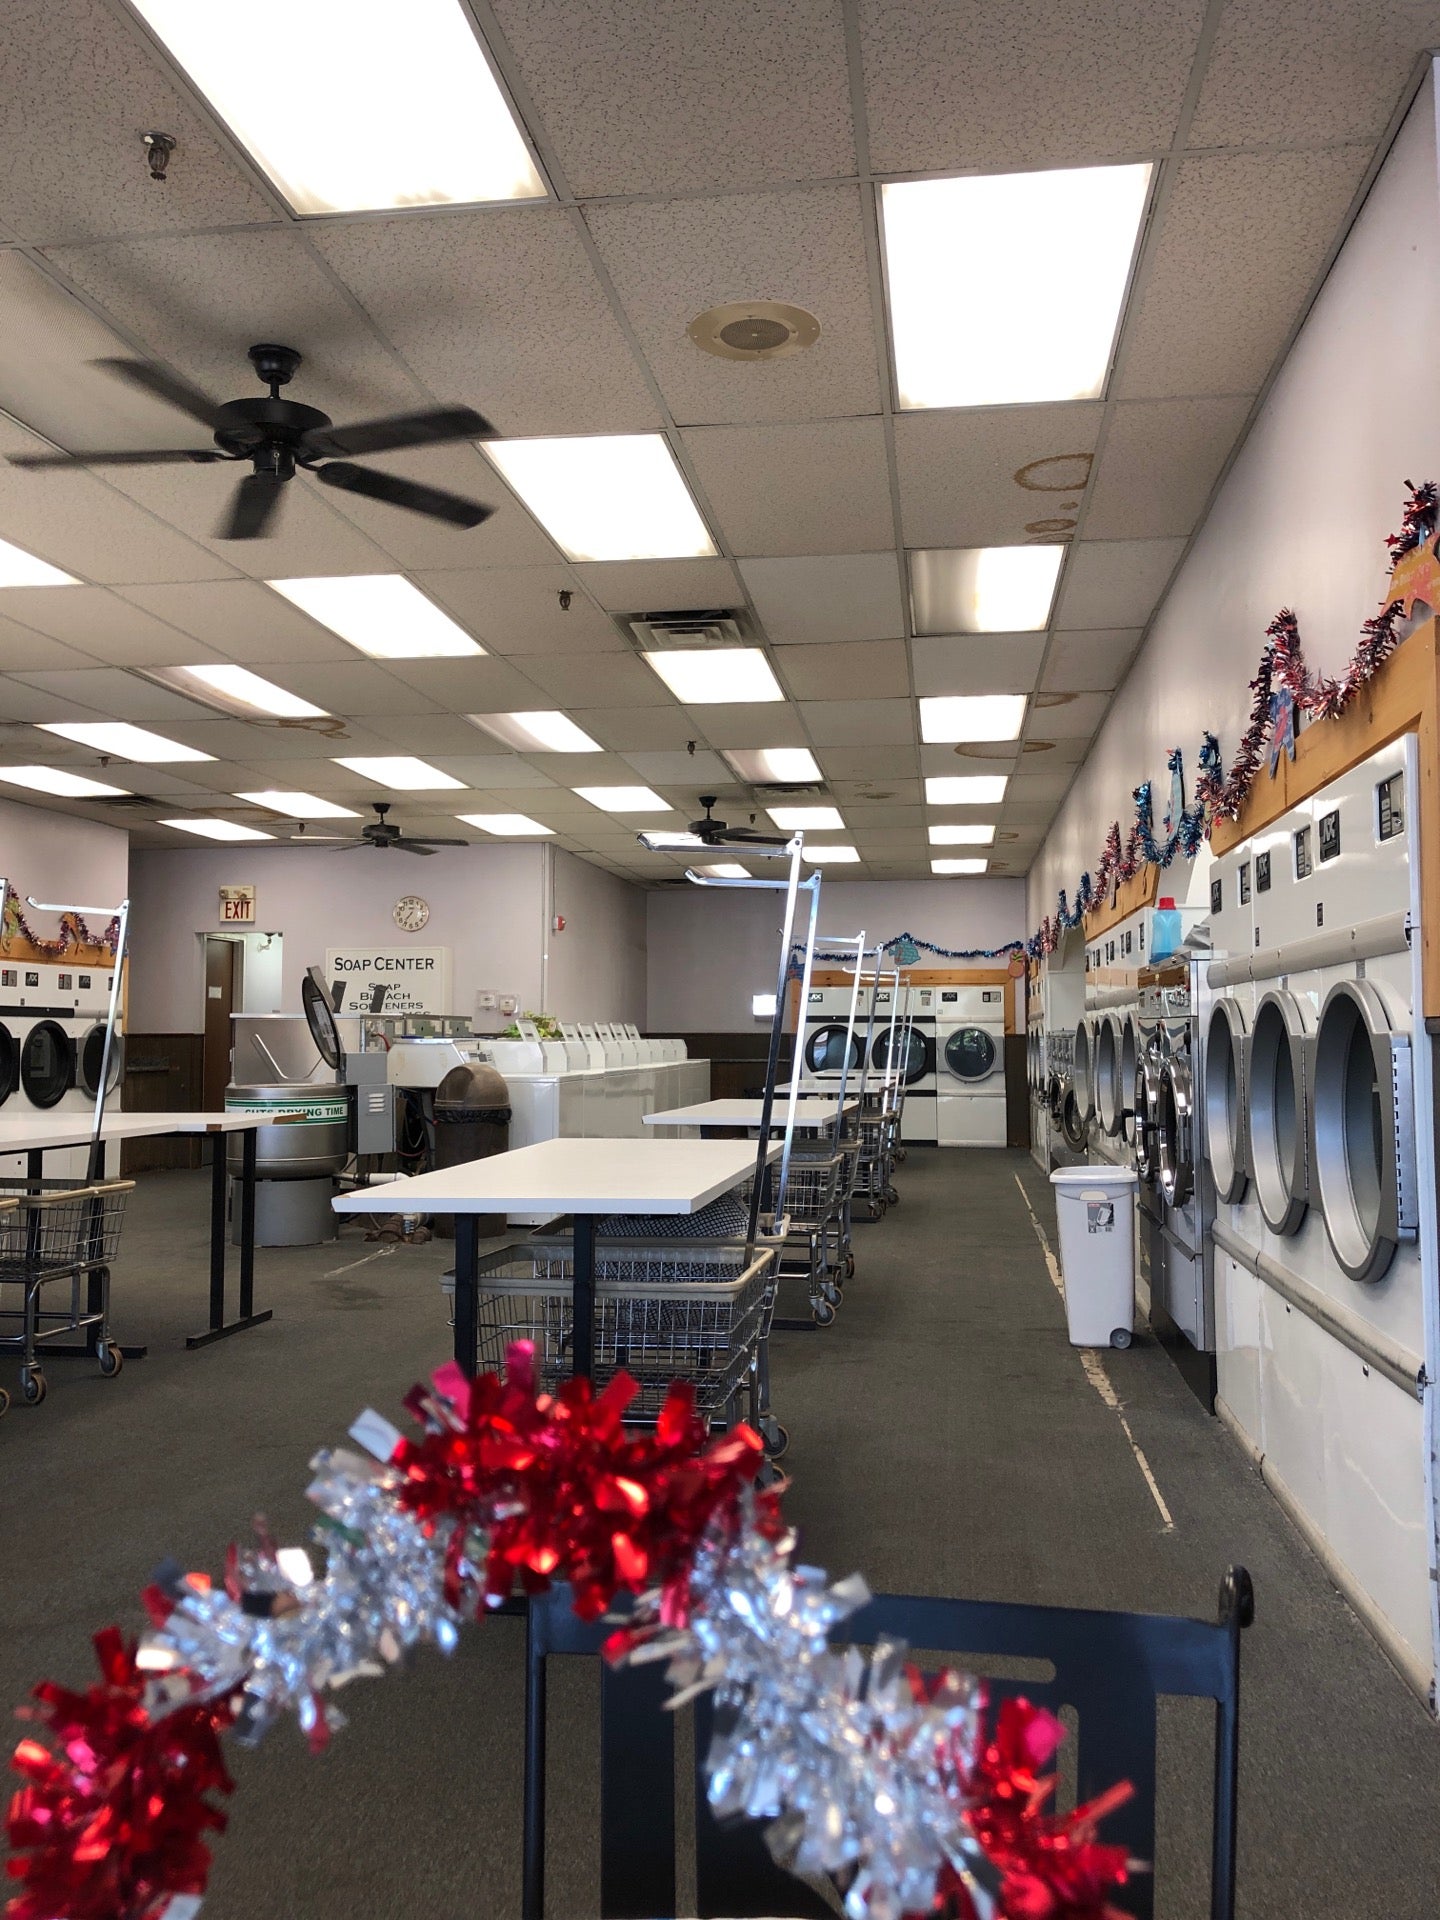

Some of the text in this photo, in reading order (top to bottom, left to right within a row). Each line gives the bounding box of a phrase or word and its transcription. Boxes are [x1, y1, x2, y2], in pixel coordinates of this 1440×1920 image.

[225, 901, 251, 919] EXIT
[334, 956, 434, 971] SOAP CENTER
[368, 982, 401, 991] SAP
[360, 992, 411, 1001] BLACH
[349, 1001, 424, 1010] SOENERS
[325, 1106, 344, 1115] TIME
